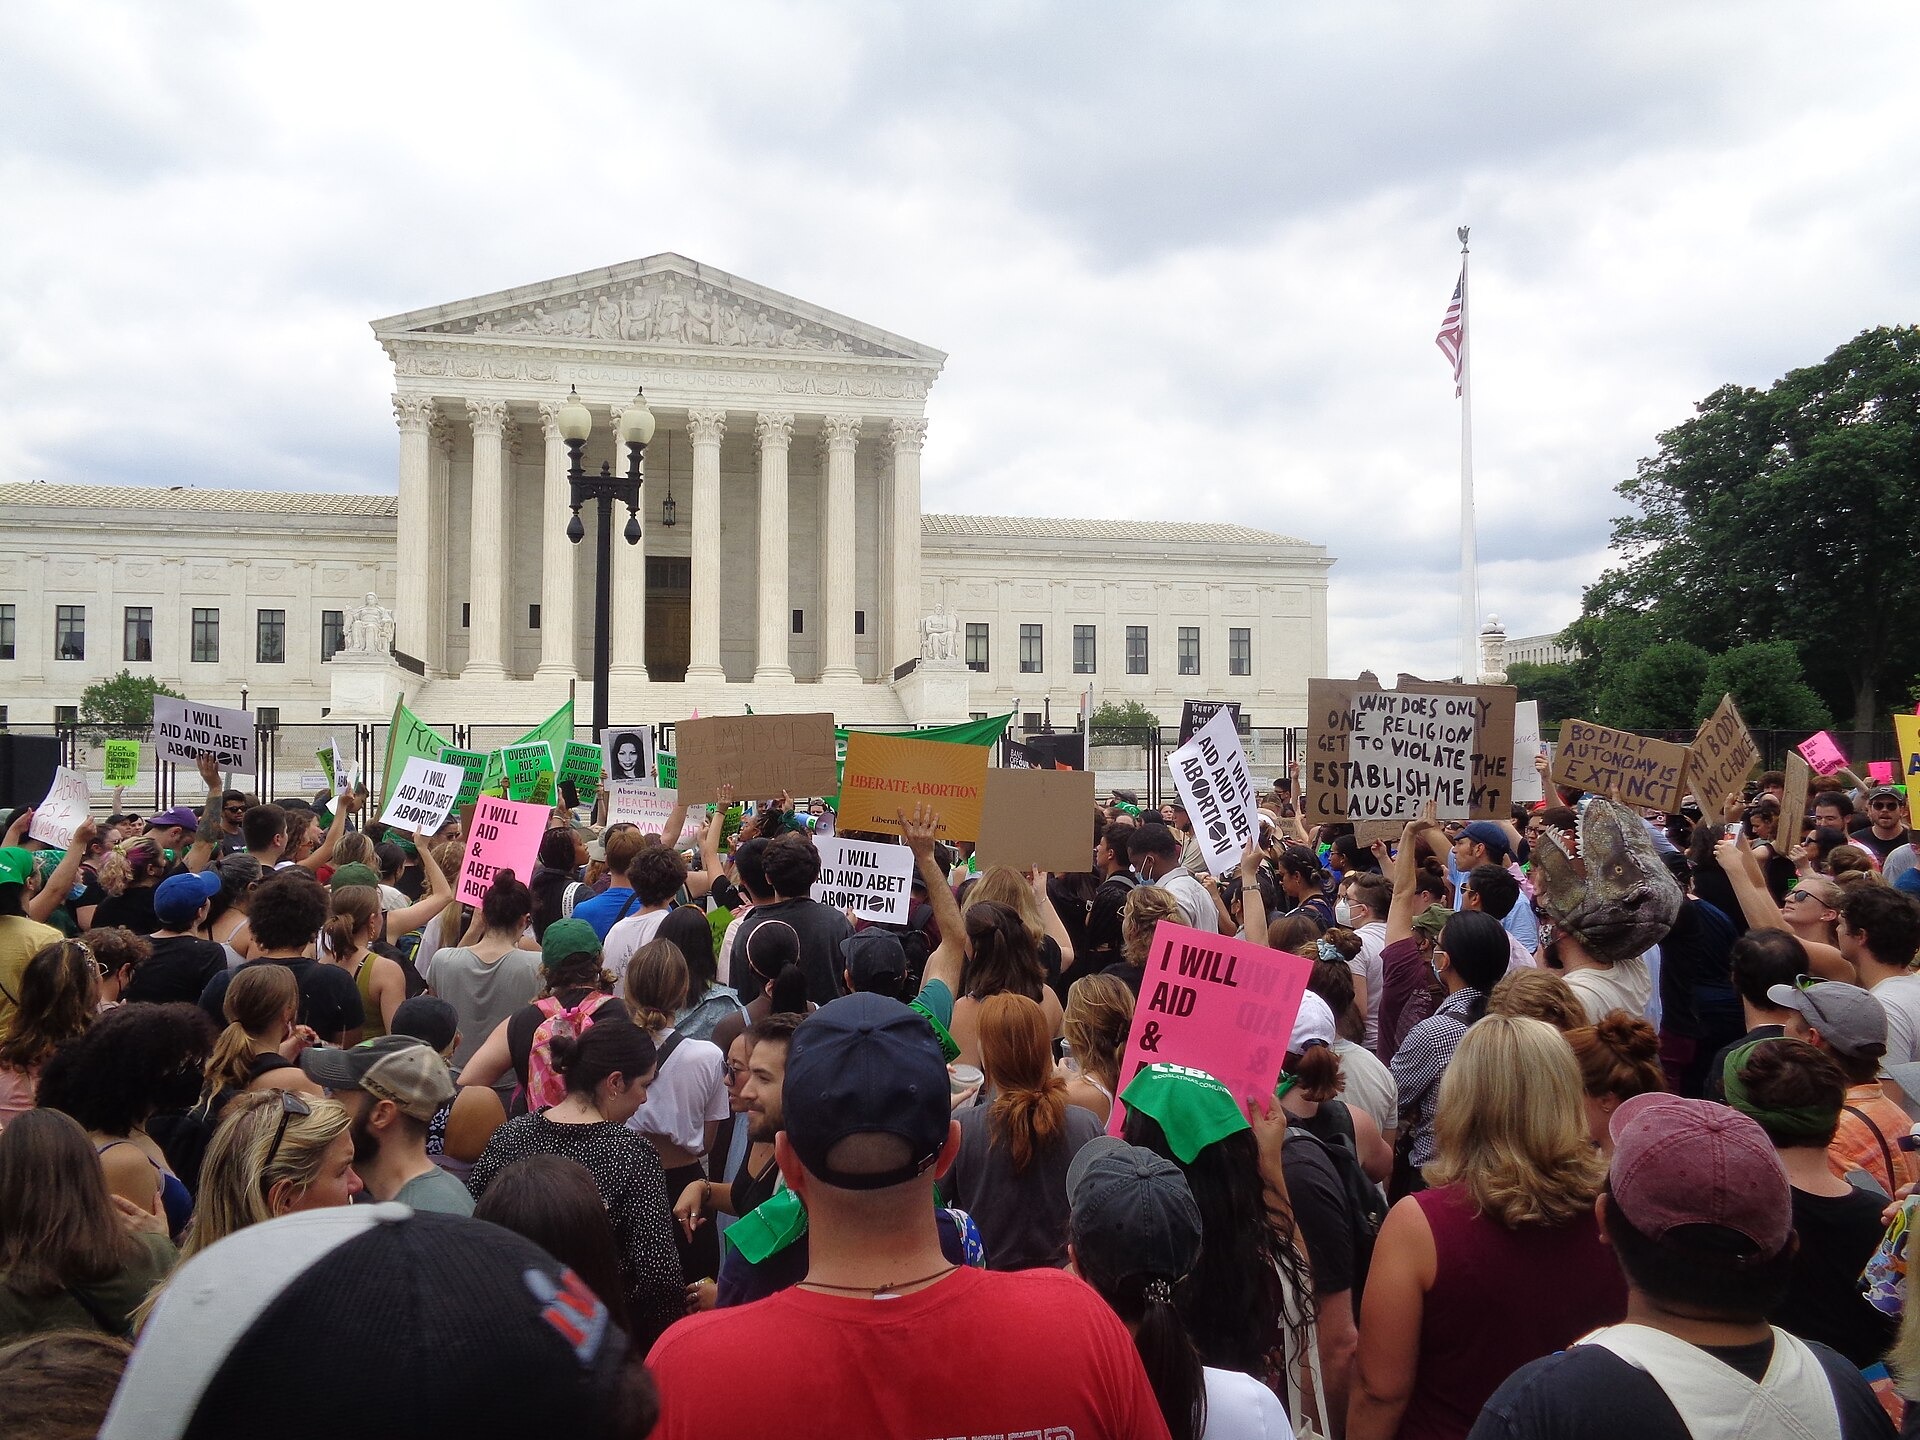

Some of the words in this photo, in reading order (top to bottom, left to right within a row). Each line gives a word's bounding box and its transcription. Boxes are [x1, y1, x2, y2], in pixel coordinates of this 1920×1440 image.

[569, 368, 620, 382] EQUAL
[623, 369, 679, 385] JUSTICE
[686, 373, 733, 387] UNDER
[740, 376, 768, 388] LAW
[184, 708, 188, 723] I
[193, 711, 222, 729] WILL
[1359, 693, 1397, 714] WHY
[1401, 697, 1438, 719] DOES
[1446, 697, 1491, 728] ONLY
[160, 722, 181, 738] AID
[184, 727, 210, 744] AND
[213, 733, 248, 751] ABET
[716, 723, 745, 754] MY
[751, 719, 829, 754] BODY
[1328, 709, 1367, 732] ONE
[1383, 716, 1472, 744] RELIGION
[1571, 724, 1647, 755] BODILY
[1690, 746, 1709, 780] MY
[1706, 704, 1741, 757] BODY
[445, 753, 483, 768] ABORTION
[508, 746, 546, 760] OVERTURN
[1226, 750, 1237, 763] I
[1318, 734, 1347, 752] GET
[1355, 736, 1384, 751] TO
[1391, 737, 1465, 770] VIOLATE
[1470, 753, 1507, 777] THE
[1563, 742, 1658, 777] AUTONOMY
[1659, 765, 1677, 782] IS
[422, 769, 429, 784] I
[429, 770, 447, 788] WILL
[514, 771, 533, 784] HELL
[565, 759, 598, 773] SOLICITUD
[1198, 735, 1220, 767] AID
[1211, 767, 1236, 804] AND
[1702, 770, 1723, 806] MY
[1721, 731, 1755, 784] CHOICE
[850, 774, 910, 793] LIBERATE
[911, 782, 978, 799] ABORTION
[1231, 760, 1251, 808] WILL
[1564, 759, 1677, 806] EXTINCT
[397, 784, 417, 801] AID
[415, 789, 435, 806] AND
[433, 793, 453, 810] ABET
[617, 797, 657, 809] HEALTH
[480, 804, 487, 819] I
[489, 805, 518, 826] WILL
[617, 807, 641, 816] BODILY
[475, 823, 499, 841] AID
[471, 842, 482, 858] &
[838, 848, 843, 865] I
[848, 849, 879, 869] WILL
[836, 870, 864, 888] AND
[866, 873, 905, 893] ABET
[1160, 940, 1174, 972] I
[1178, 944, 1238, 988] WILL
[1148, 981, 1197, 1018] AID
[1139, 1020, 1163, 1053] &
